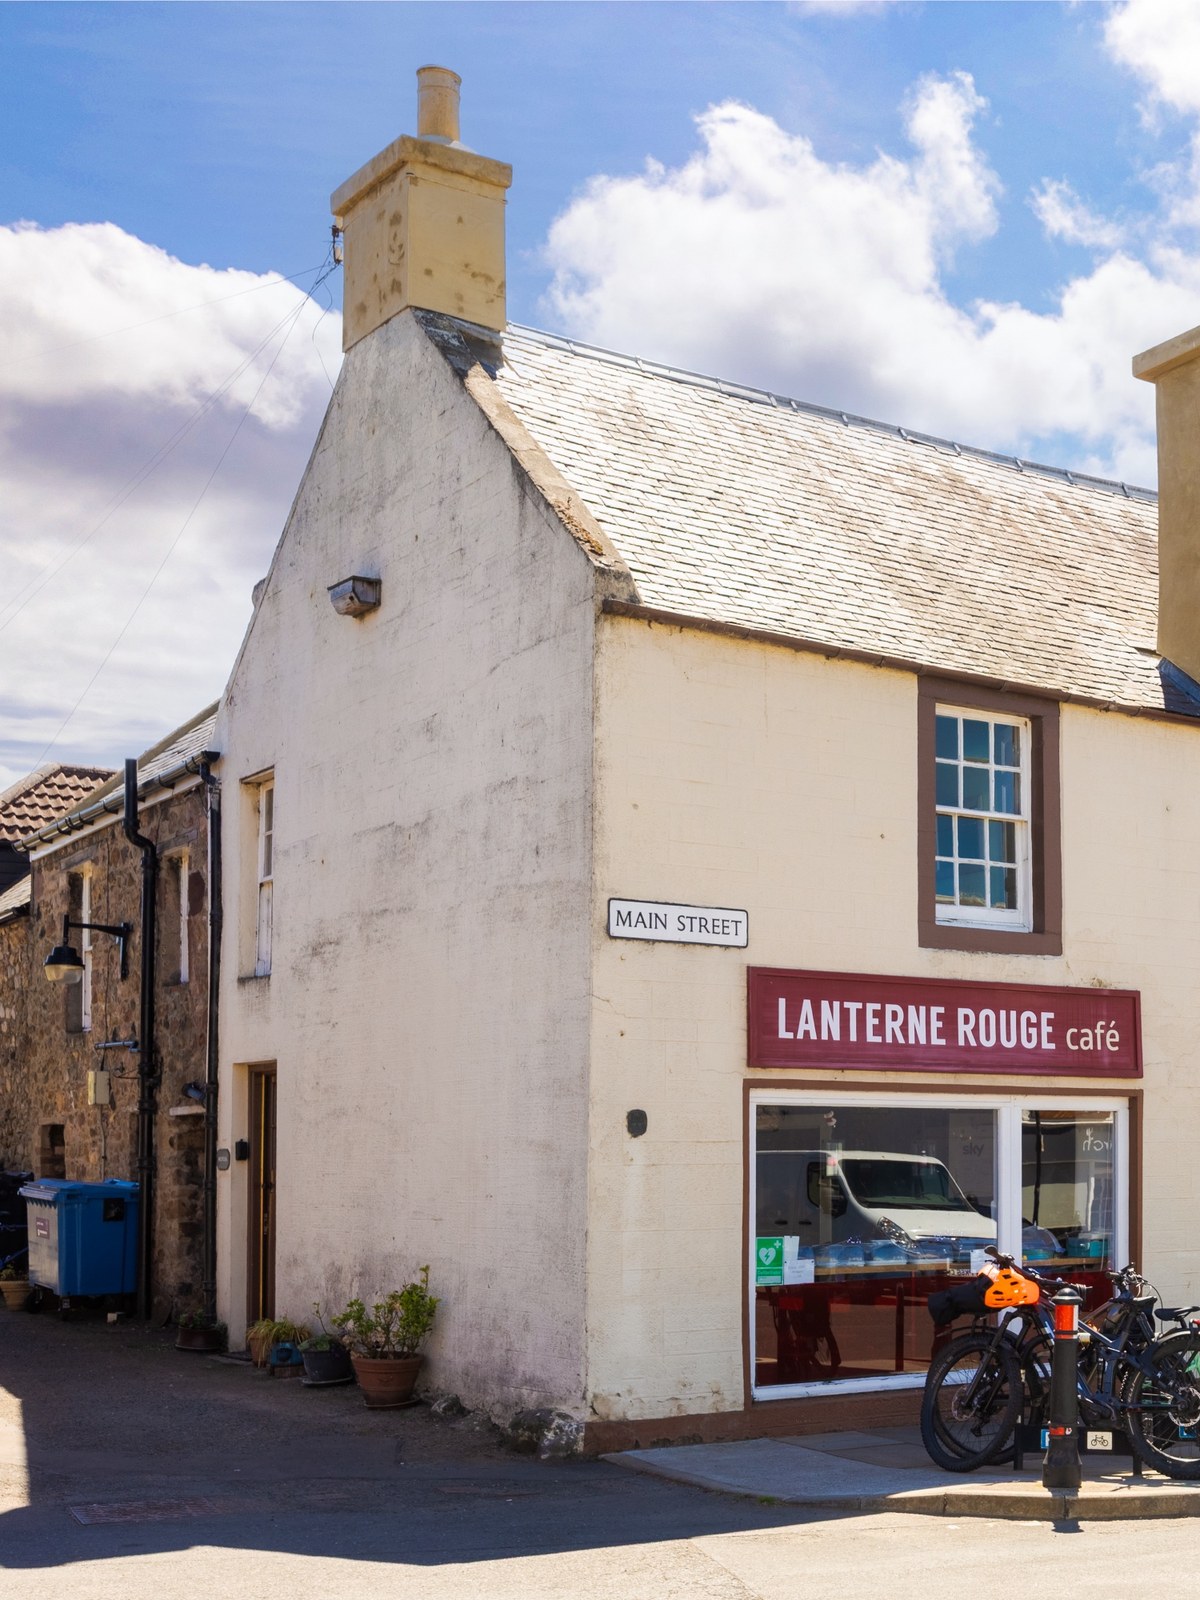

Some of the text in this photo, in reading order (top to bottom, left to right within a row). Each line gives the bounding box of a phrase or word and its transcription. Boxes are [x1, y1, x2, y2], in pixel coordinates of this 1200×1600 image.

[616, 910, 742, 936] MAIN STREET
[778, 997, 1120, 1051] LANTERNE ROUGE café
